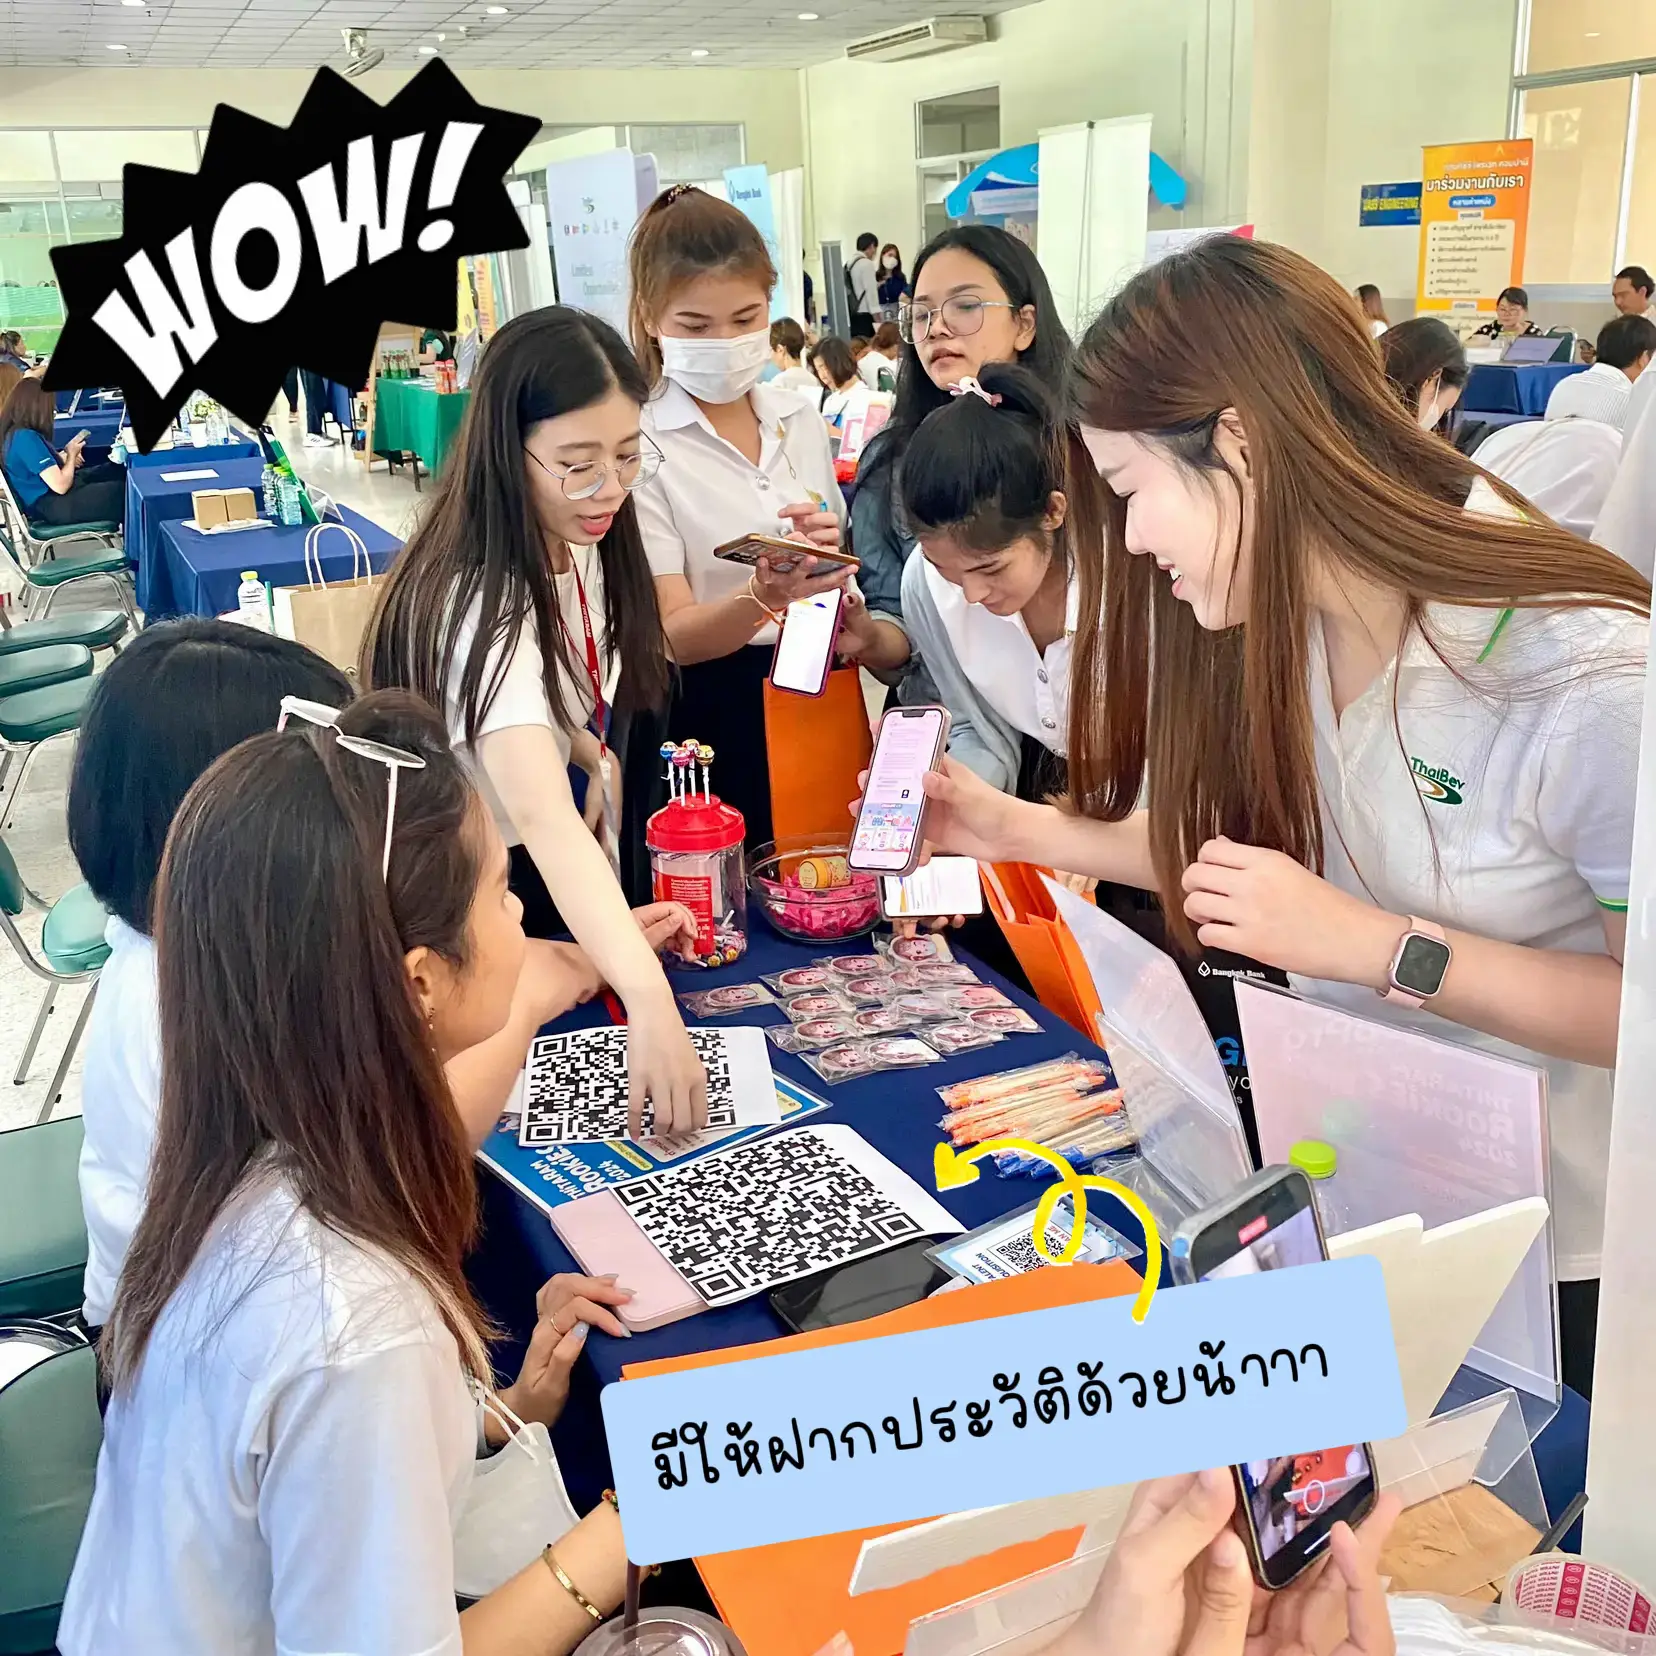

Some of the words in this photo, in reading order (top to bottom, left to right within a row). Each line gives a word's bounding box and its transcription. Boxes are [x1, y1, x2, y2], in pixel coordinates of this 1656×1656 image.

[1426, 171, 1524, 191] มาร่วมงานกับเรา
[1410, 756, 1466, 790] ThaiBev
[1212, 968, 1245, 978] Bangkok
[1246, 969, 1266, 979] Bank
[530, 1159, 586, 1200] THITARAM
[598, 1160, 632, 1181] 2024
[971, 1263, 996, 1281] ALENT
[975, 1252, 1011, 1278] QUISITION
